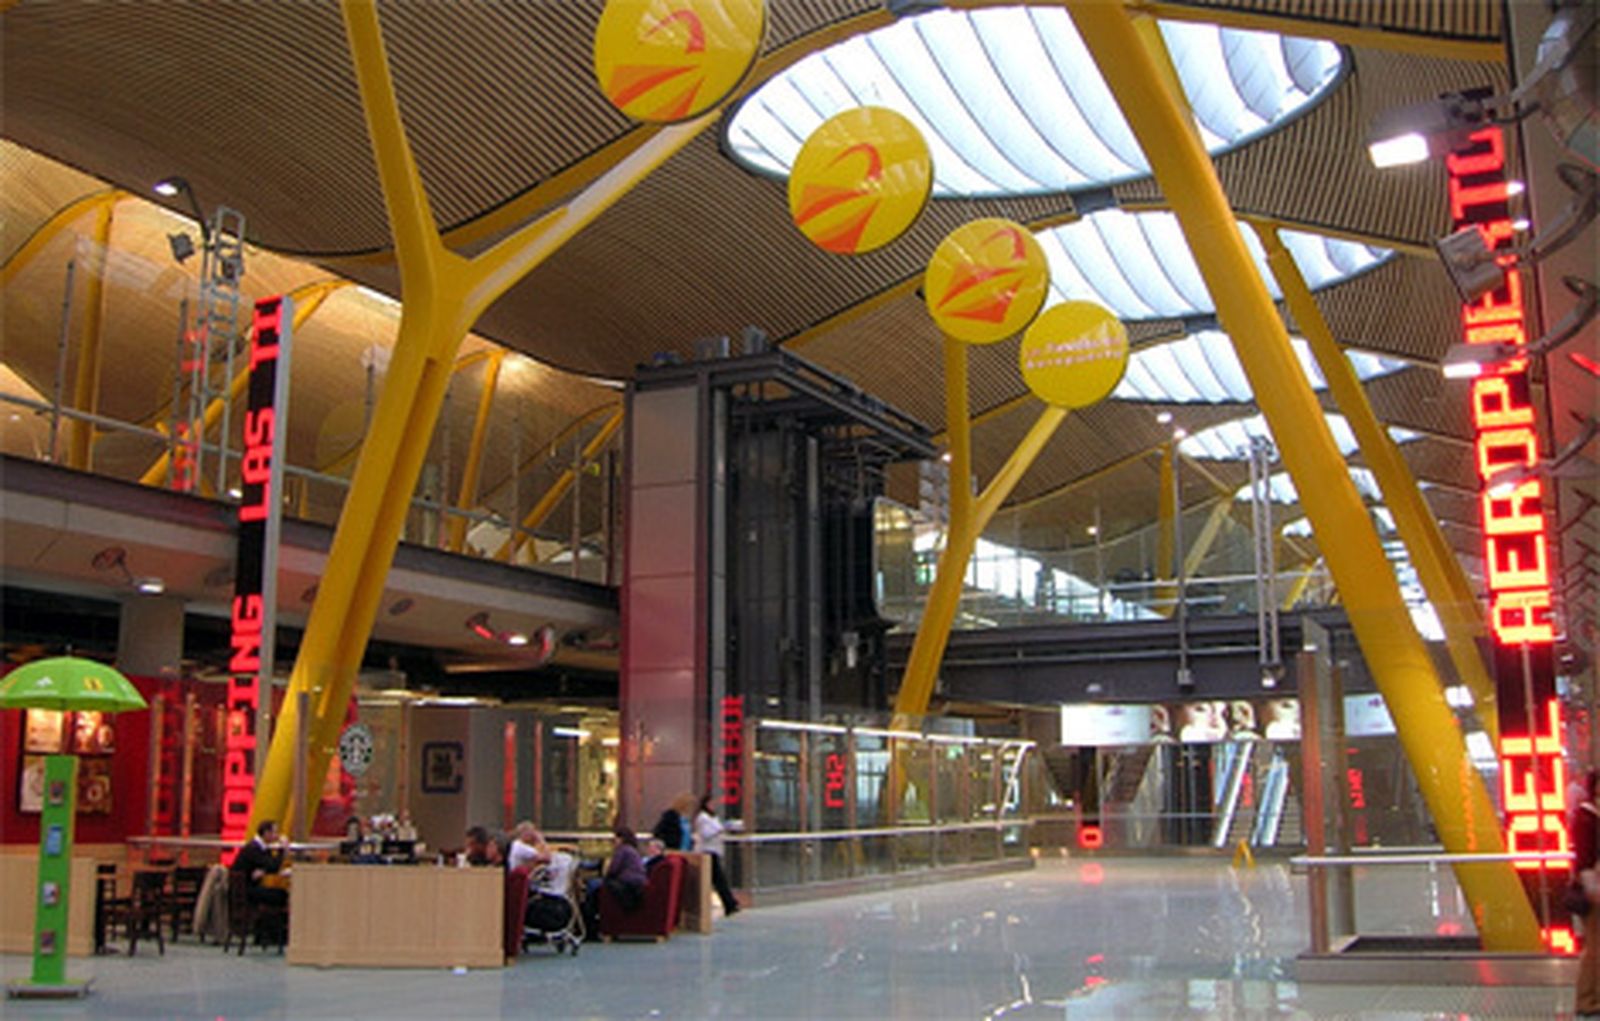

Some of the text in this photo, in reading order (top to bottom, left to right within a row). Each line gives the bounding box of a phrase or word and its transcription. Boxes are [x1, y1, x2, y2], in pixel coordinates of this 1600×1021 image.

[252, 294, 283, 370] TI
[239, 407, 276, 523] LAS
[1500, 698, 1572, 869] DEL
